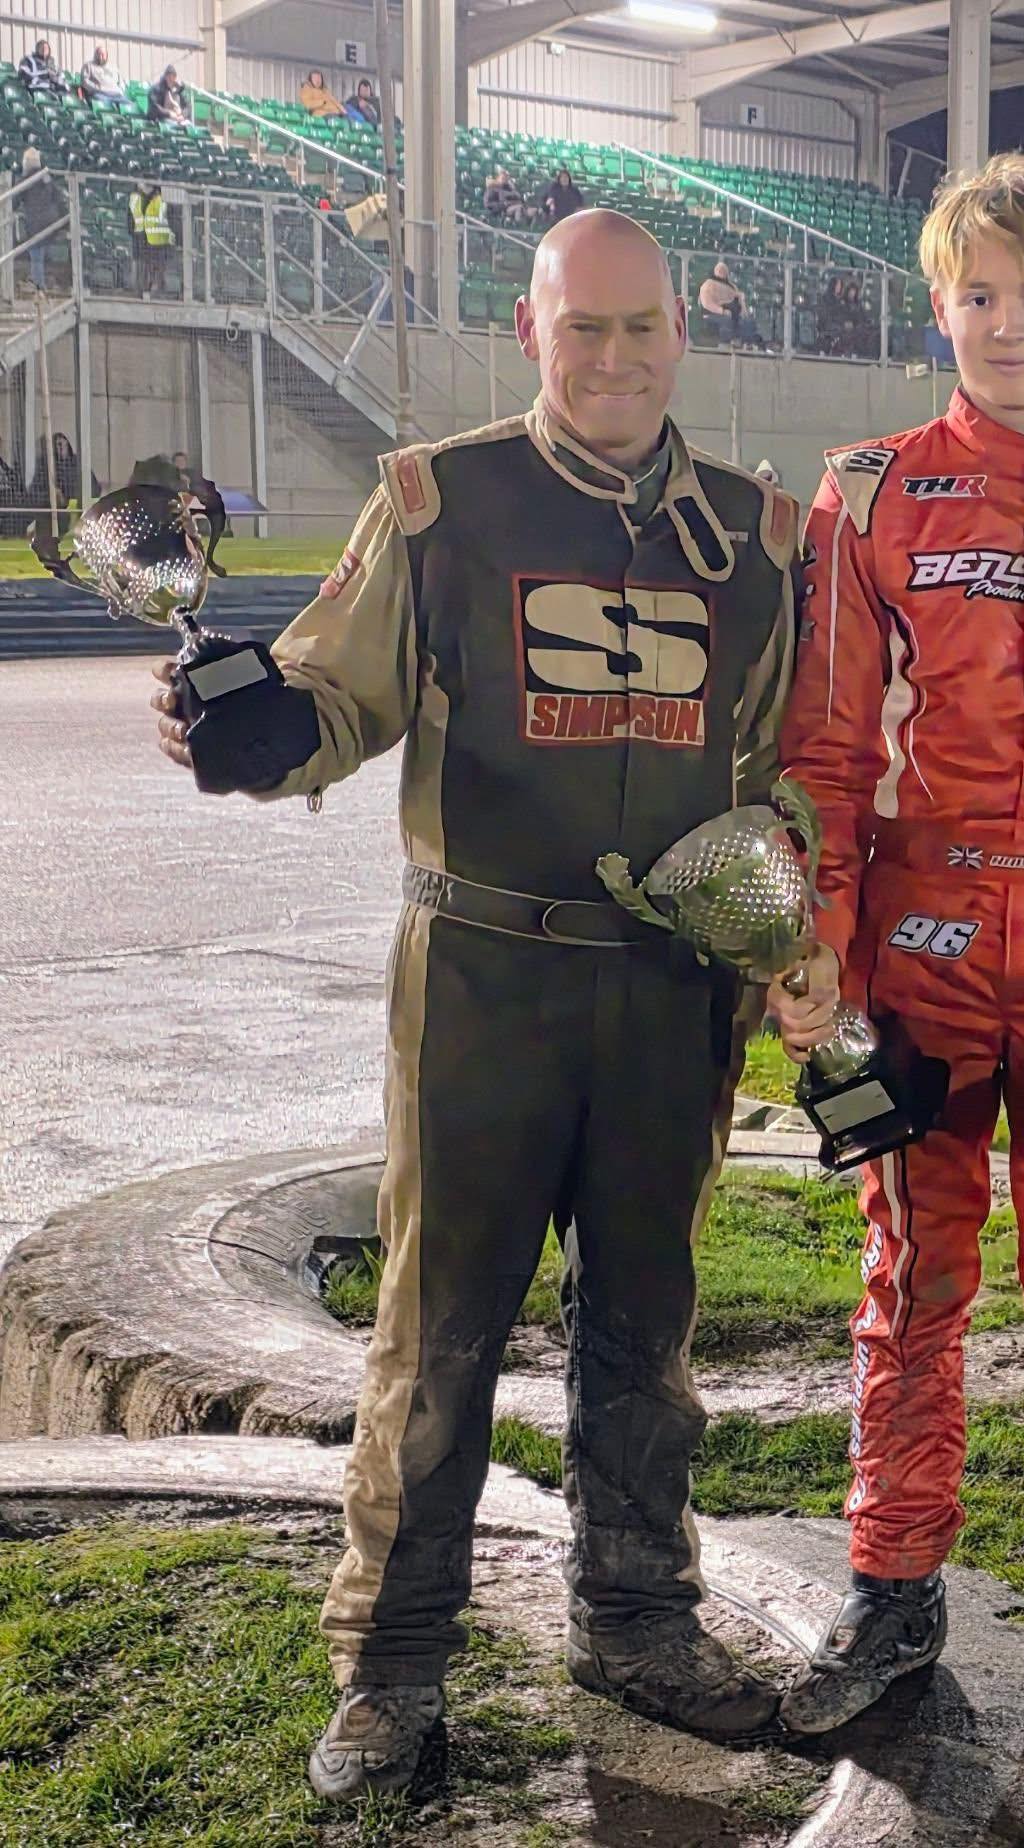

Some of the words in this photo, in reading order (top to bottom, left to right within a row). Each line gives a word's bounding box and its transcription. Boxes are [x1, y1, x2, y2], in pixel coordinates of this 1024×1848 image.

[345, 44, 357, 64] E
[747, 107, 757, 125] F
[904, 475, 987, 497] THR
[529, 695, 701, 741] SIMPSON
[887, 914, 979, 957] 96
